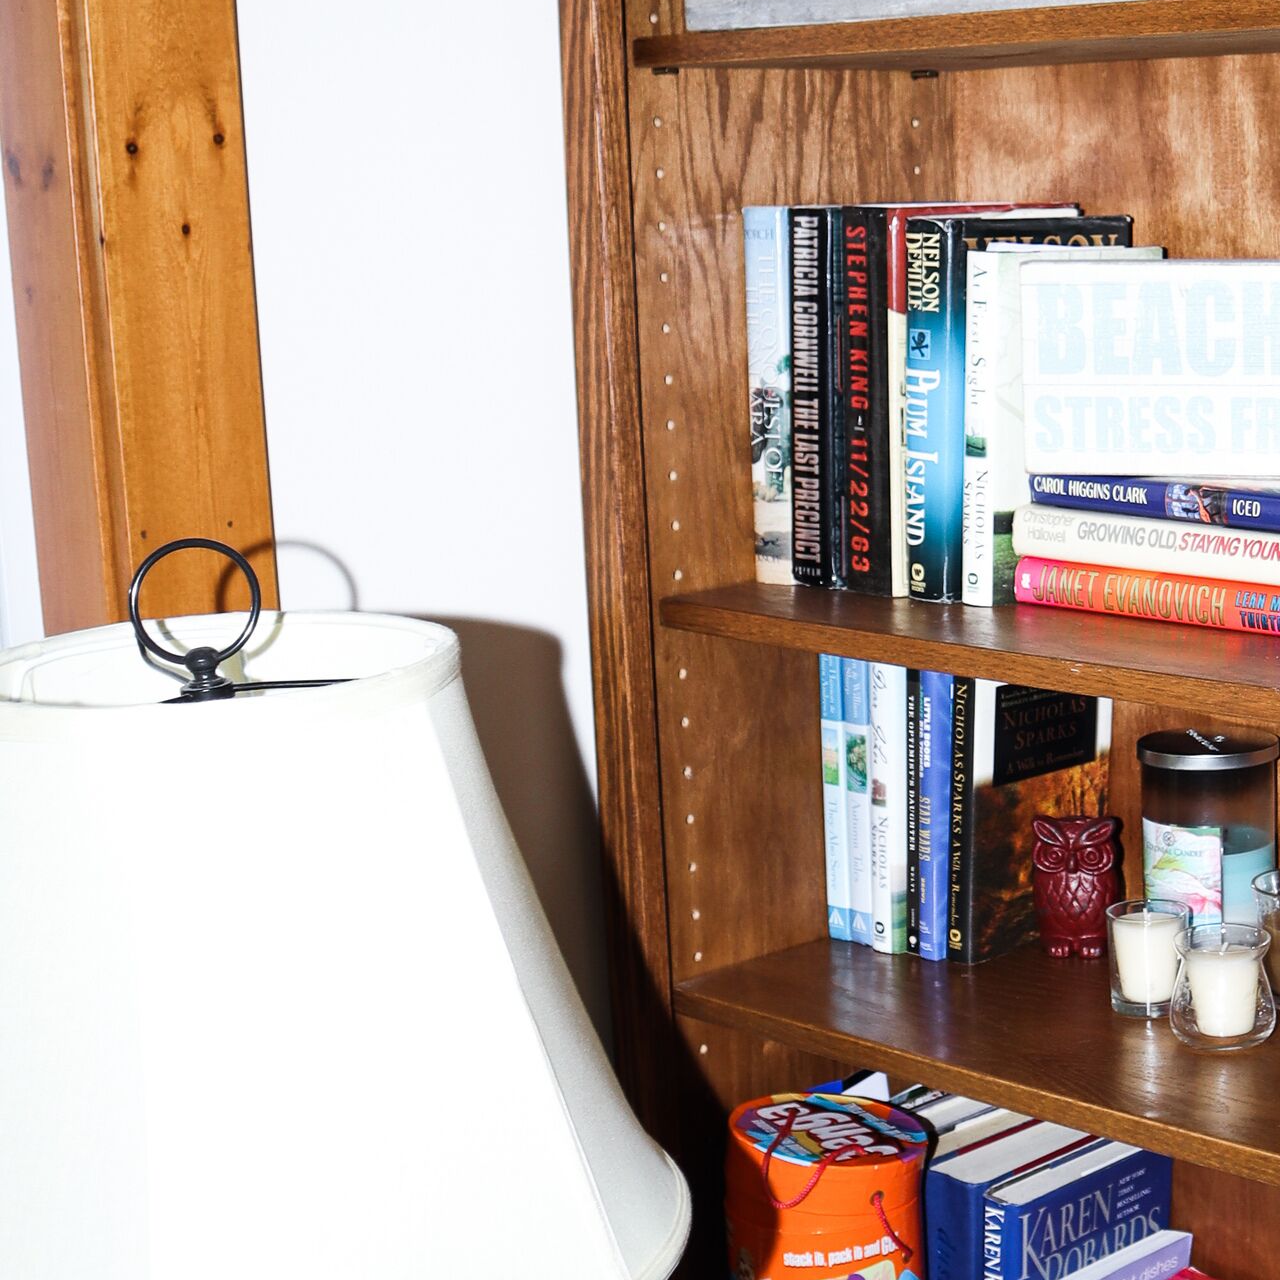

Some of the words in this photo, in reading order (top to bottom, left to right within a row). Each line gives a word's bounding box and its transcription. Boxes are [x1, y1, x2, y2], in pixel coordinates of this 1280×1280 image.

[794, 216, 818, 297] PATRICIA
[846, 226, 868, 337] STEPHEN
[905, 233, 923, 312] DEMILLE
[922, 233, 940, 313] NELSON
[793, 301, 819, 393] CORNWELL
[850, 348, 870, 410] KING
[905, 368, 941, 439] PLUM
[794, 398, 820, 430] THE
[1034, 395, 1217, 455] STRESS
[794, 434, 820, 475] LAST
[795, 477, 821, 563] PRECINCT
[850, 437, 871, 572] 11/22/63
[905, 452, 939, 546] ISLAND
[975, 470, 989, 560] NICHOLAS
[1023, 510, 1076, 527] Christopher
[1033, 475, 1067, 496] CAROL
[1068, 480, 1111, 501] HIGGINS
[1112, 485, 1148, 505] CLARK
[1232, 498, 1261, 518] ICED
[1077, 521, 1147, 547] GROWING
[1178, 531, 1244, 557] STAYING
[1033, 565, 1099, 608] JANET
[1104, 573, 1227, 626] EVANOVICH
[1235, 591, 1266, 609] LEAN
[954, 683, 967, 770] NICHOLAS
[1003, 697, 1087, 731] NICHOLAS
[1014, 721, 1077, 751] SPARKS
[919, 796, 931, 826] STAR
[953, 770, 966, 835] SPARKS
[877, 815, 889, 889] NICHOLAS
[919, 829, 931, 863] WARS
[783, 1251, 813, 1267] stack
[828, 1249, 852, 1268] pack
[853, 1245, 863, 1260] it
[864, 1239, 881, 1258] and
[984, 1205, 1005, 1272] KAREN
